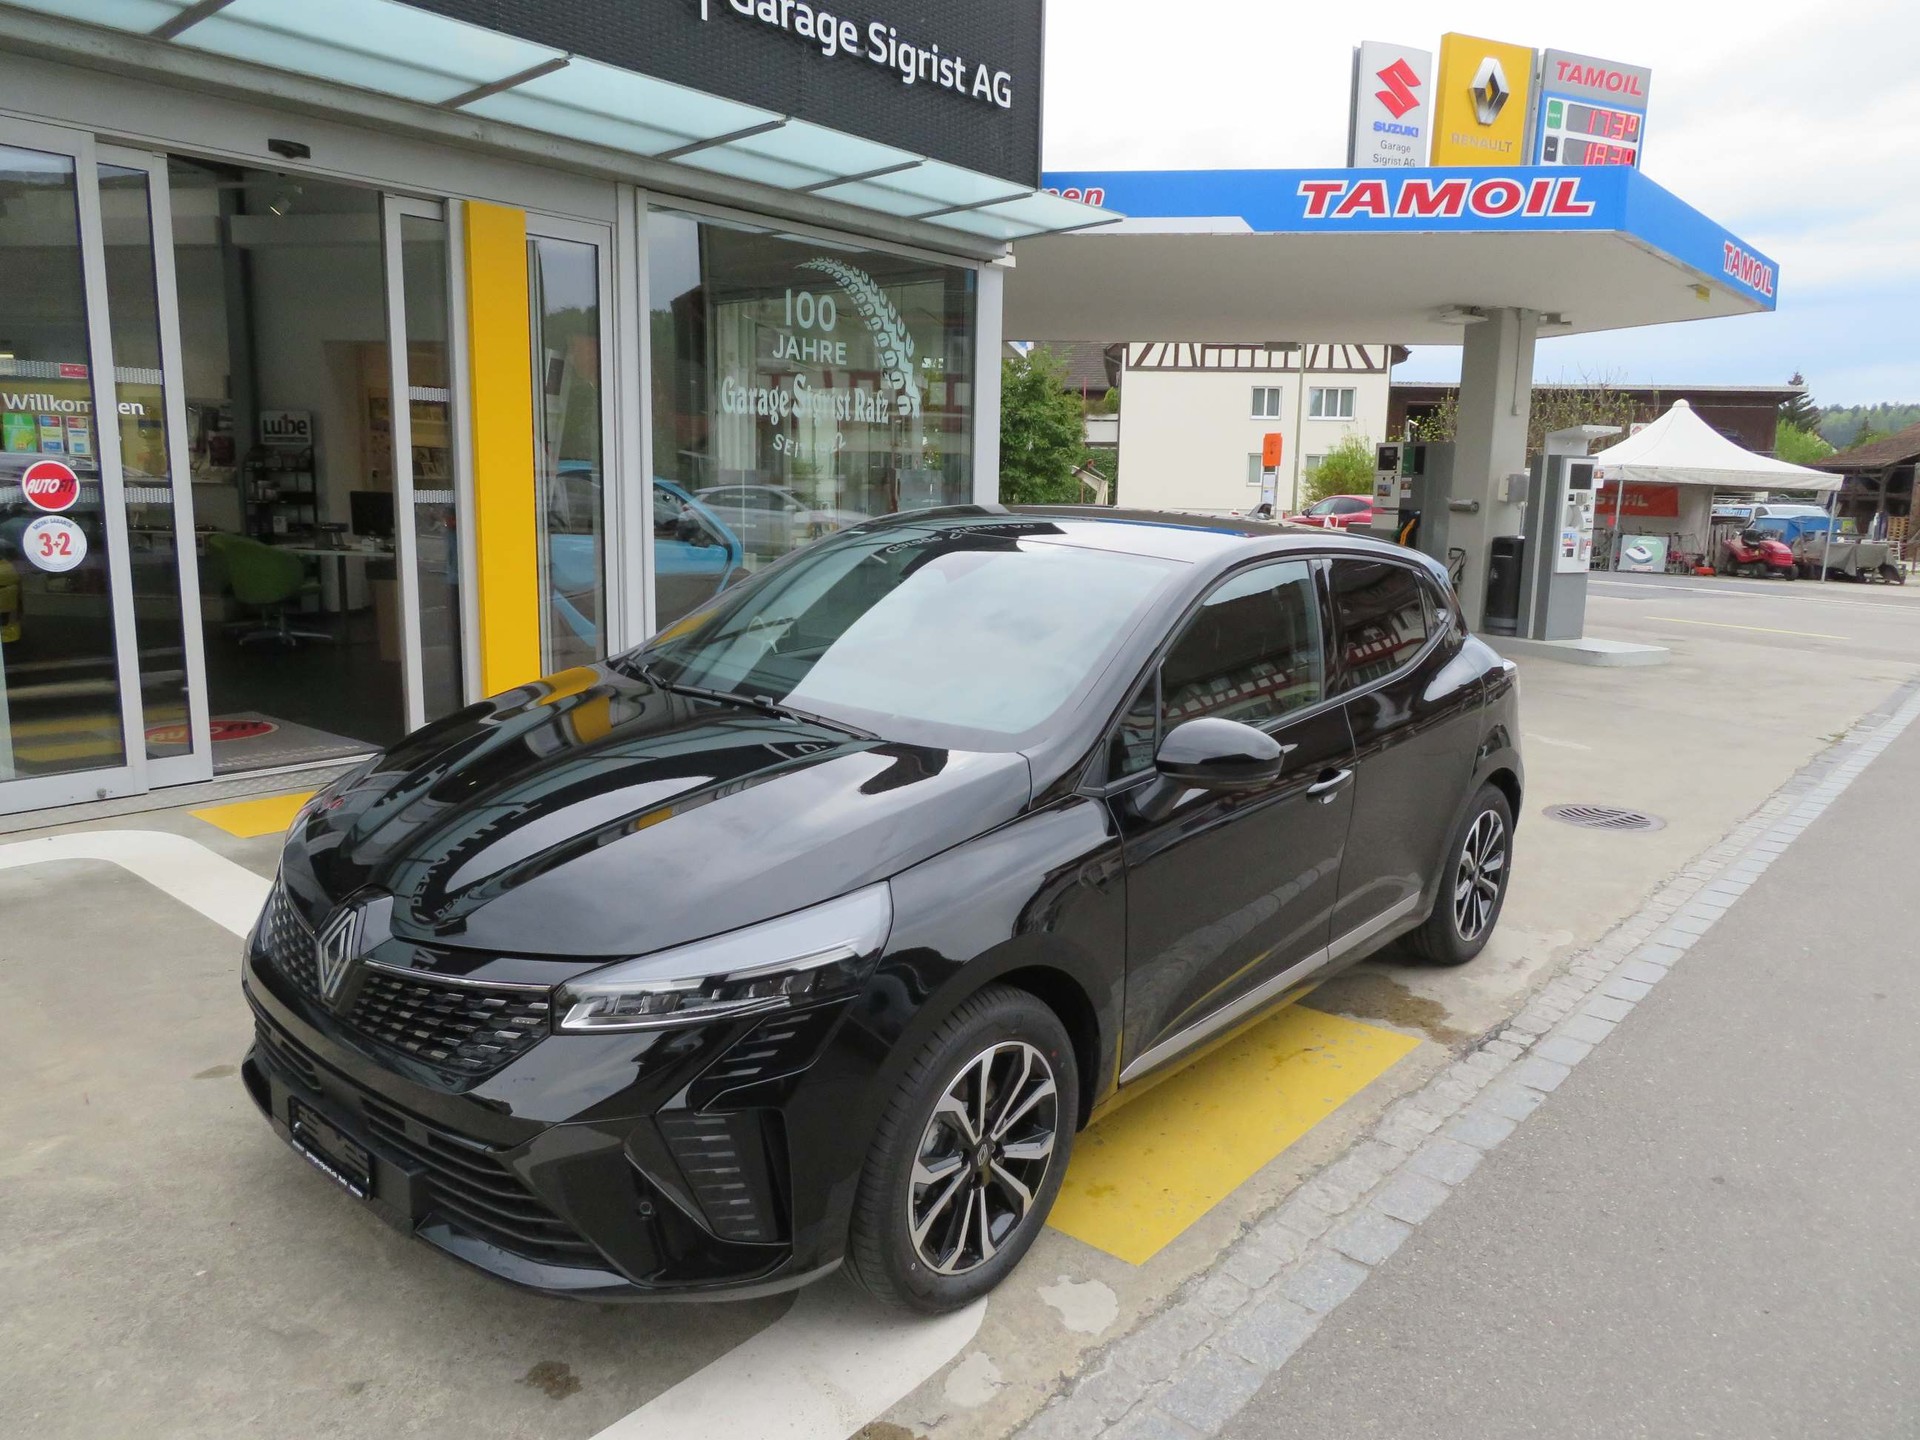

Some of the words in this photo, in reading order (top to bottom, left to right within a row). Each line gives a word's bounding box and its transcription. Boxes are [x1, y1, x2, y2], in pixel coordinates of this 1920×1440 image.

[868, 22, 966, 93] Sigrist
[971, 63, 1012, 108] AG
[1556, 61, 1642, 96] TAMOIL
[1373, 121, 1419, 137] SUZUKI
[1451, 132, 1512, 153] RENAULT
[1372, 153, 1401, 167] Sigrist
[1403, 157, 1416, 168] AG
[1380, 139, 1411, 155] Garage
[1298, 178, 1595, 218] TAMOIL
[1724, 240, 1773, 298] TAMOIL
[785, 288, 836, 331] 100
[772, 334, 847, 365] JAHRE
[722, 375, 790, 426] Garage
[854, 387, 889, 425] Rafz
